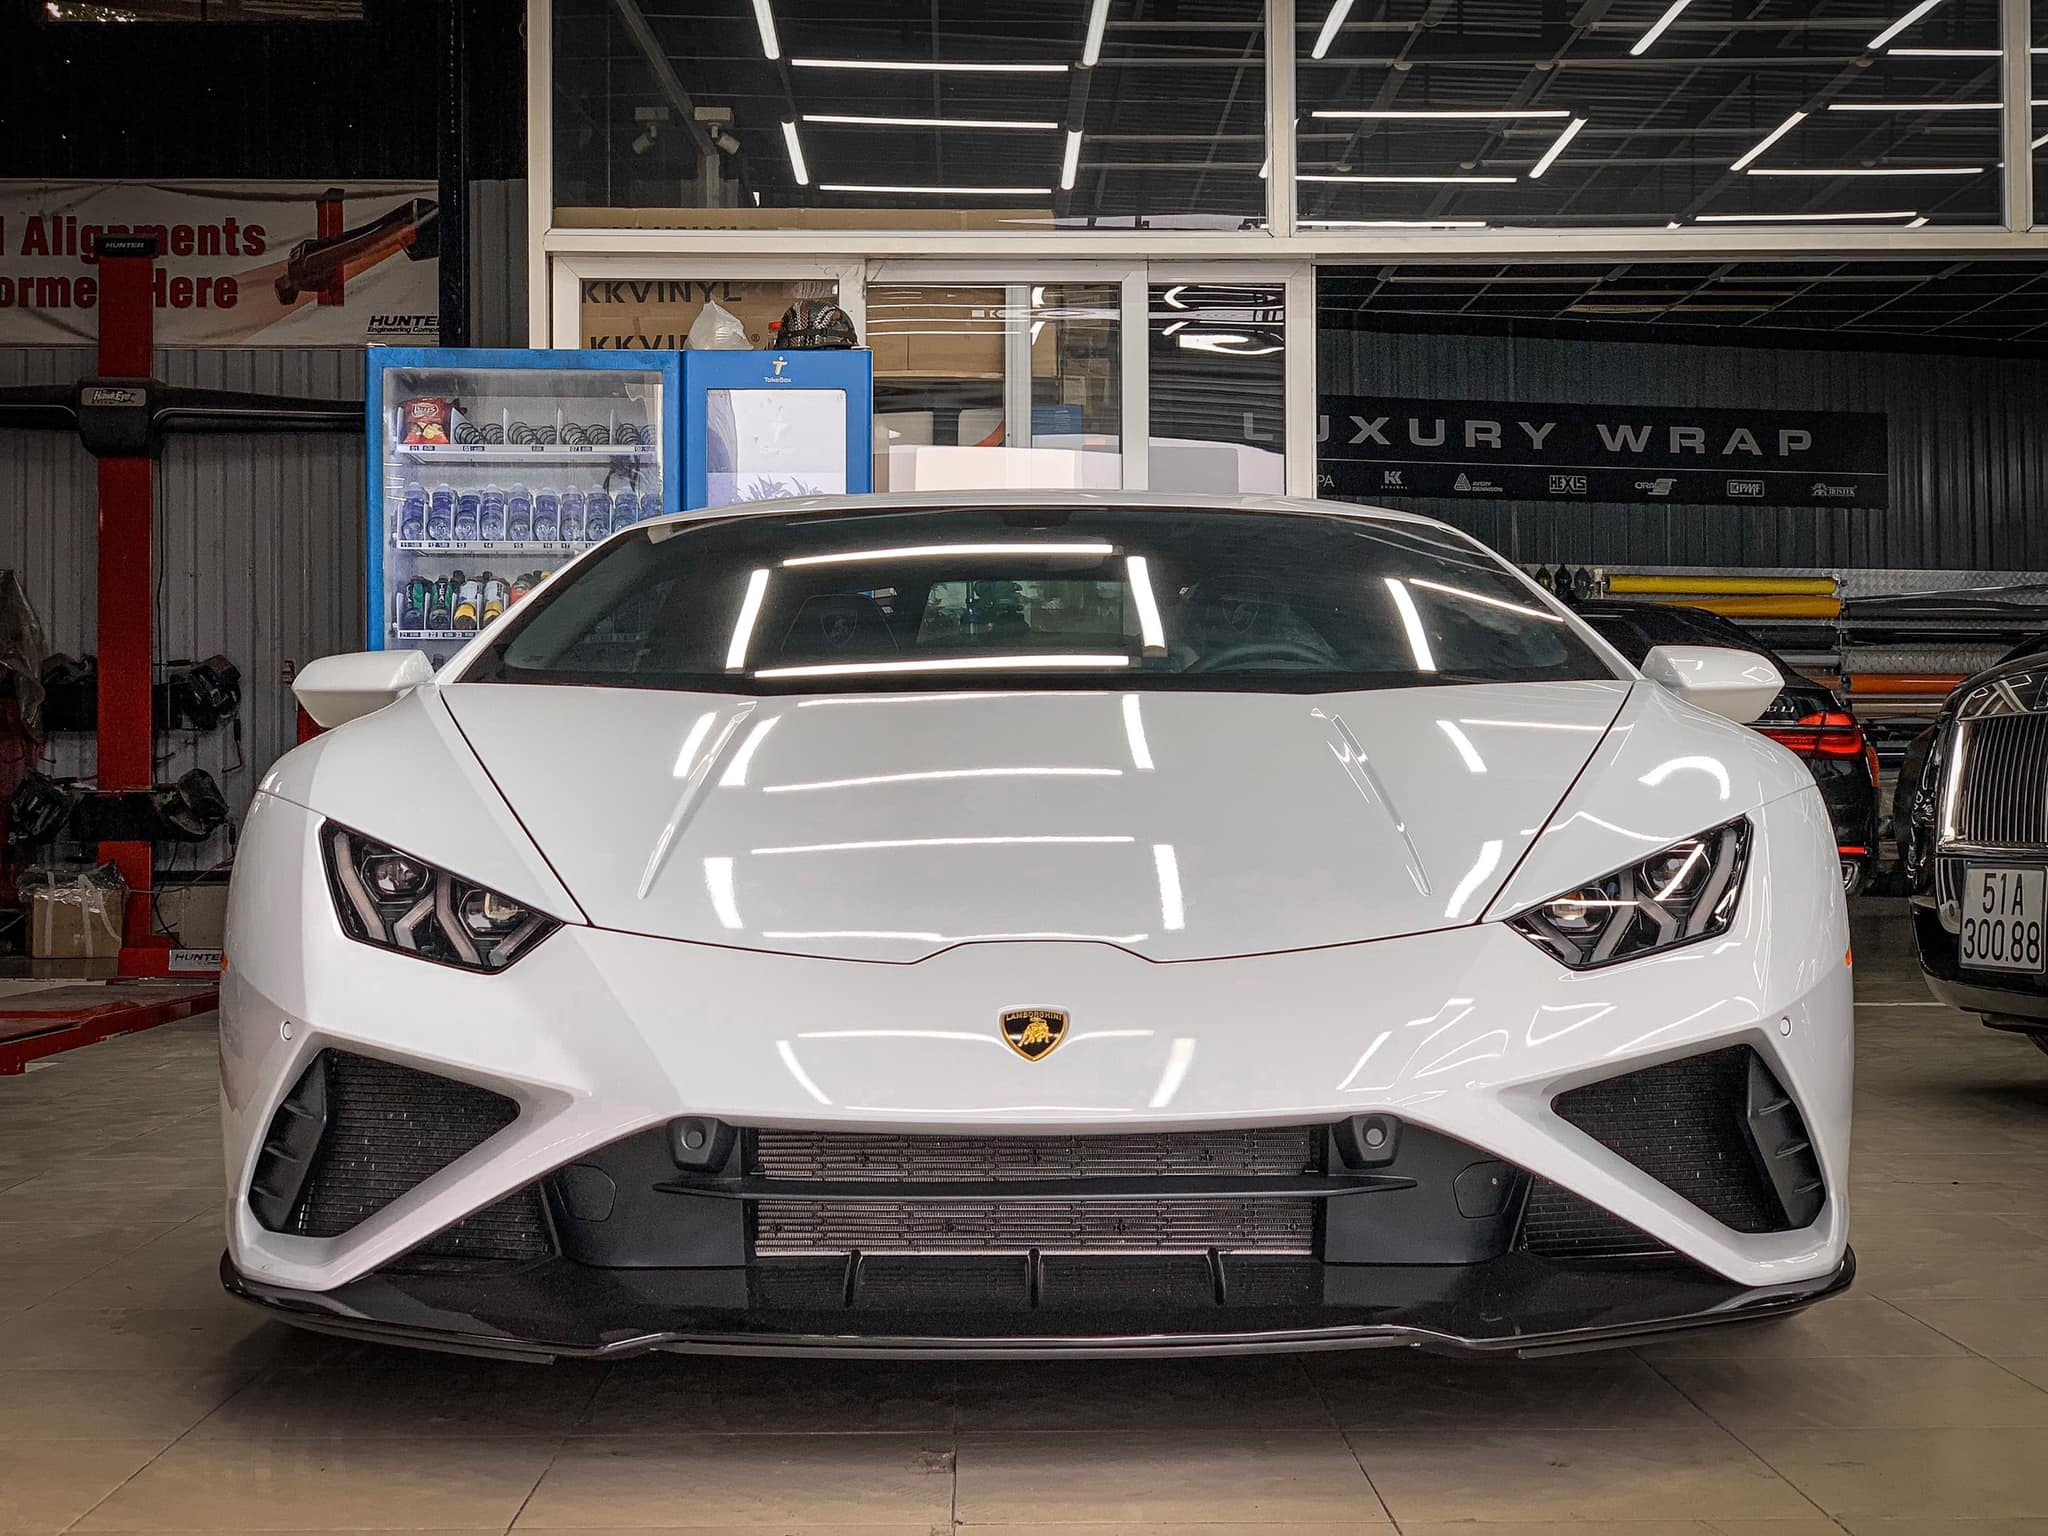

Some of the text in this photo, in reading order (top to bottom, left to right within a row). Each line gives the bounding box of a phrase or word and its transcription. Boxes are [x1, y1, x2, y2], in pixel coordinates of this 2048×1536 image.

[0, 274, 97, 309] orme
[582, 281, 742, 304] KKVINYL
[369, 315, 440, 326] HUNTE
[1596, 423, 1812, 456] WRAP
[1550, 475, 1587, 494] HEXIS
[438, 582, 446, 601] TEA
[1982, 872, 2024, 916] 51A
[1963, 918, 2040, 963] 300.88
[175, 953, 221, 961] HUNTE
